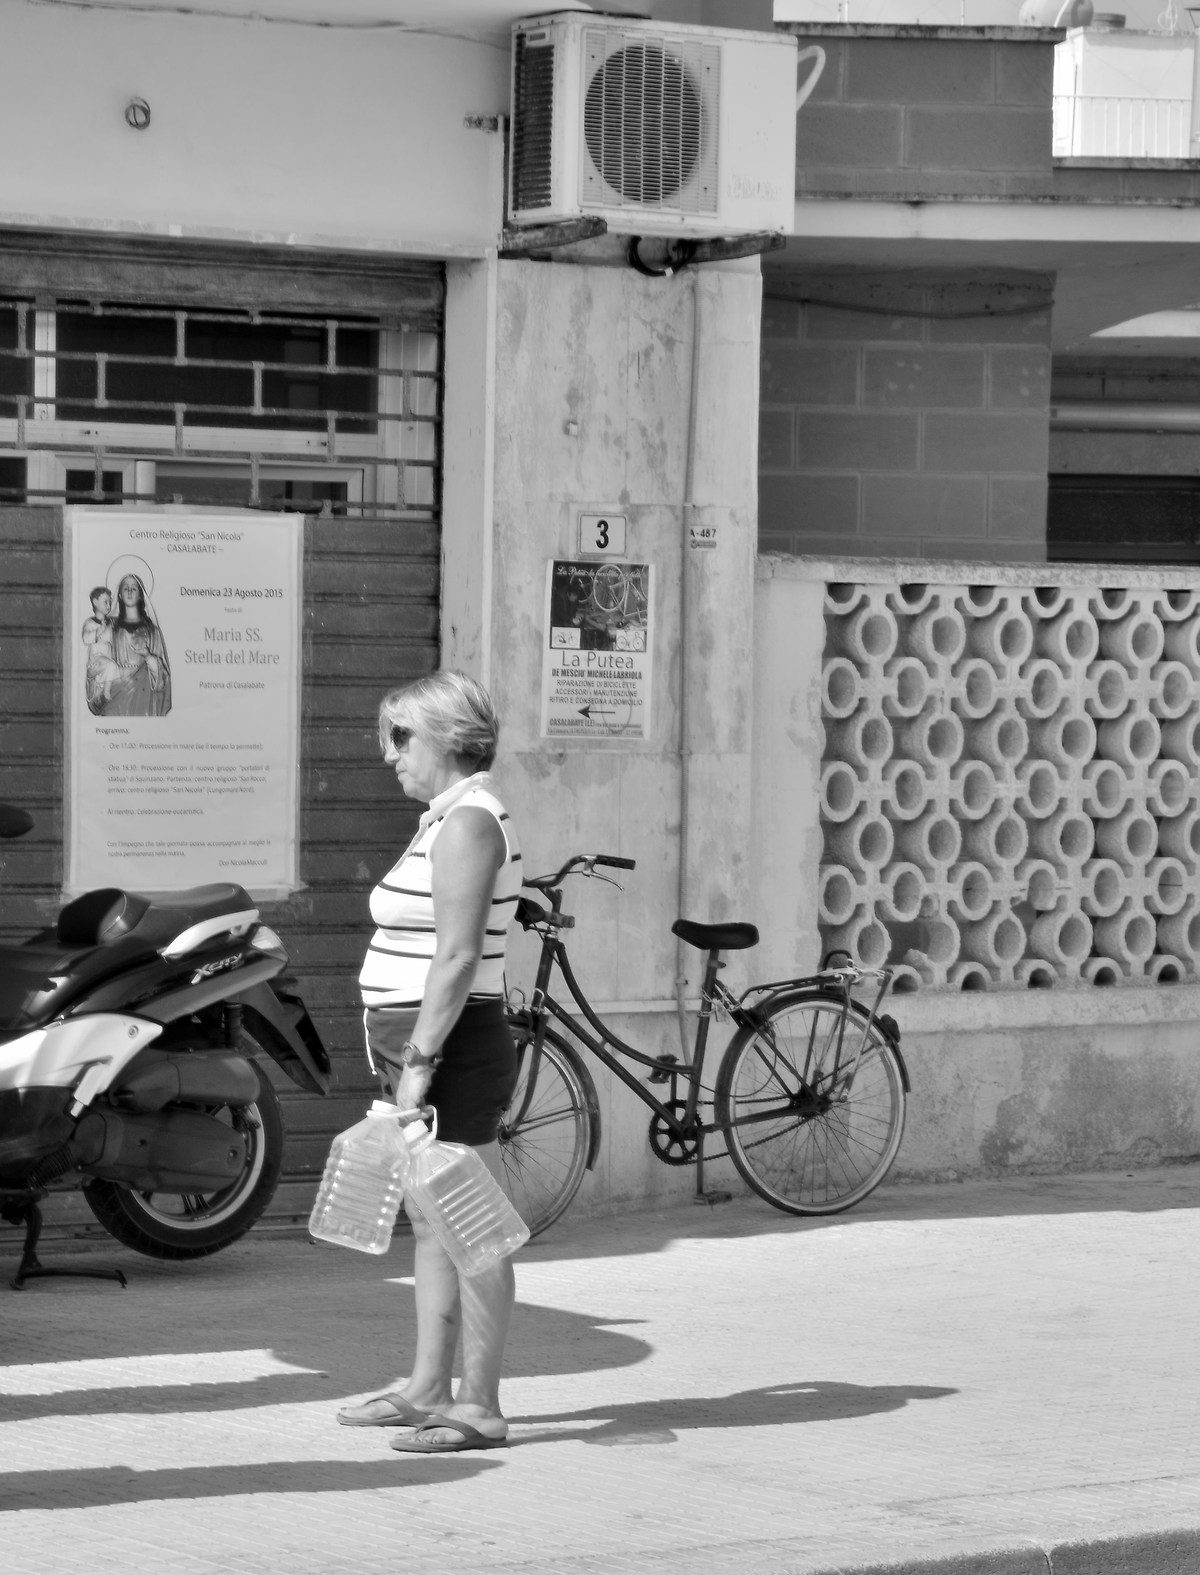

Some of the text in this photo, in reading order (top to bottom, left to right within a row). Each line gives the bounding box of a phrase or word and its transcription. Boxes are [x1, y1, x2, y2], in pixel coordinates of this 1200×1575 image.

[129, 529, 158, 540] Centro
[159, 530, 196, 542] Religioso
[595, 519, 610, 549] 3
[690, 528, 717, 539] A-487
[167, 543, 217, 553] CASALABATE
[180, 586, 283, 599] Domenica 23 Agosto 2015
[204, 626, 263, 642] Maria SS.
[184, 649, 280, 665] Stella del Mare
[562, 649, 634, 669] La Putea
[552, 668, 560, 677] DE
[587, 669, 612, 679] MICHELE
[613, 670, 642, 680] LABRIOLA
[199, 680, 225, 689] Patrona
[226, 680, 233, 689] di
[556, 679, 595, 688] RIPARAZIONE
[603, 681, 636, 689] BICICLETTE
[555, 688, 638, 698] ACCESSORI MANUTENZIONE
[575, 697, 607, 705] CONSEGNA
